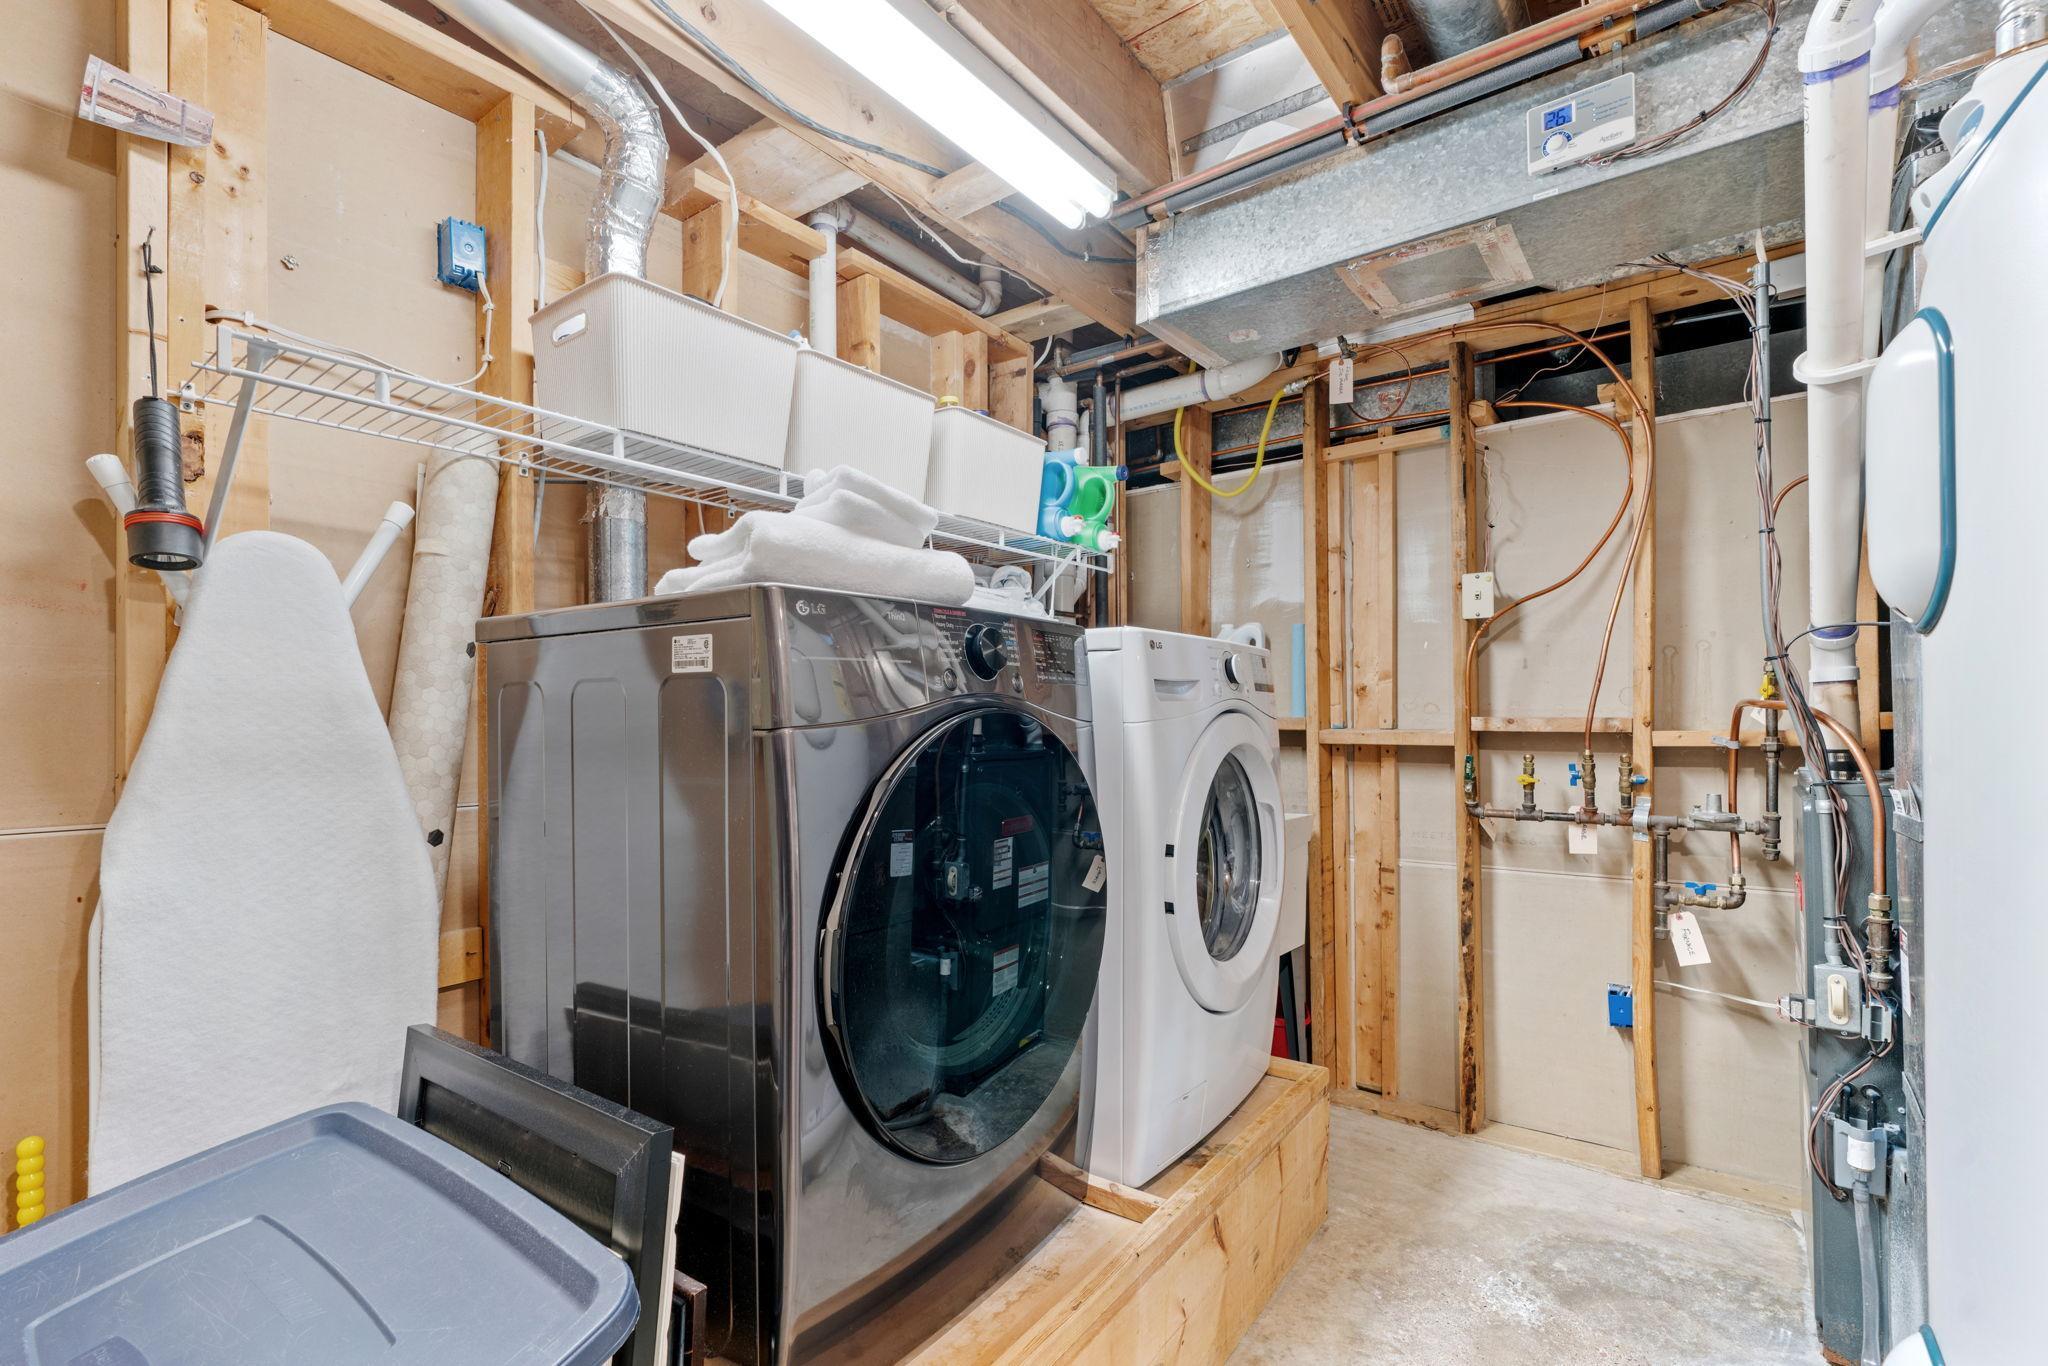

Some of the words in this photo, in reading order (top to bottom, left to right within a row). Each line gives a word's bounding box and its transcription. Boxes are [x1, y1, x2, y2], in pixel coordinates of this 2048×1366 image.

[1544, 108, 1567, 130] 26
[810, 603, 827, 615] LG
[887, 611, 906, 622] ThinQ
